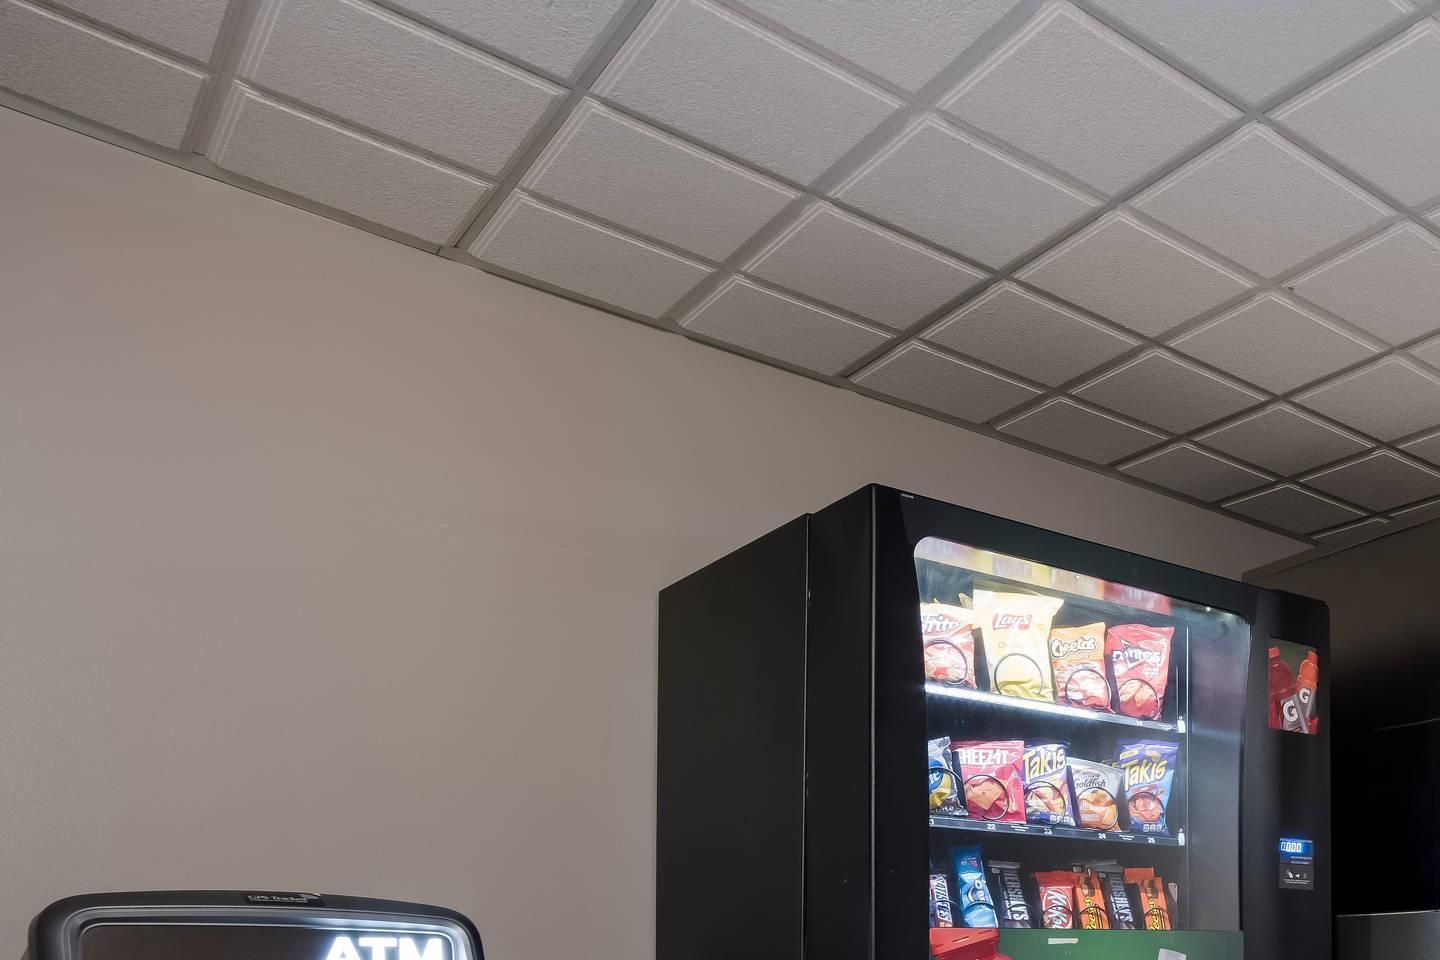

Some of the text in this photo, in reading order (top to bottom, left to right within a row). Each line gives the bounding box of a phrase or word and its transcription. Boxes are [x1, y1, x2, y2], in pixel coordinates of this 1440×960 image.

[1051, 636, 1097, 658] Cheetos
[1299, 688, 1311, 704] G
[1283, 700, 1298, 722] G
[1023, 746, 1066, 784] Takis
[1121, 760, 1168, 791] Takis
